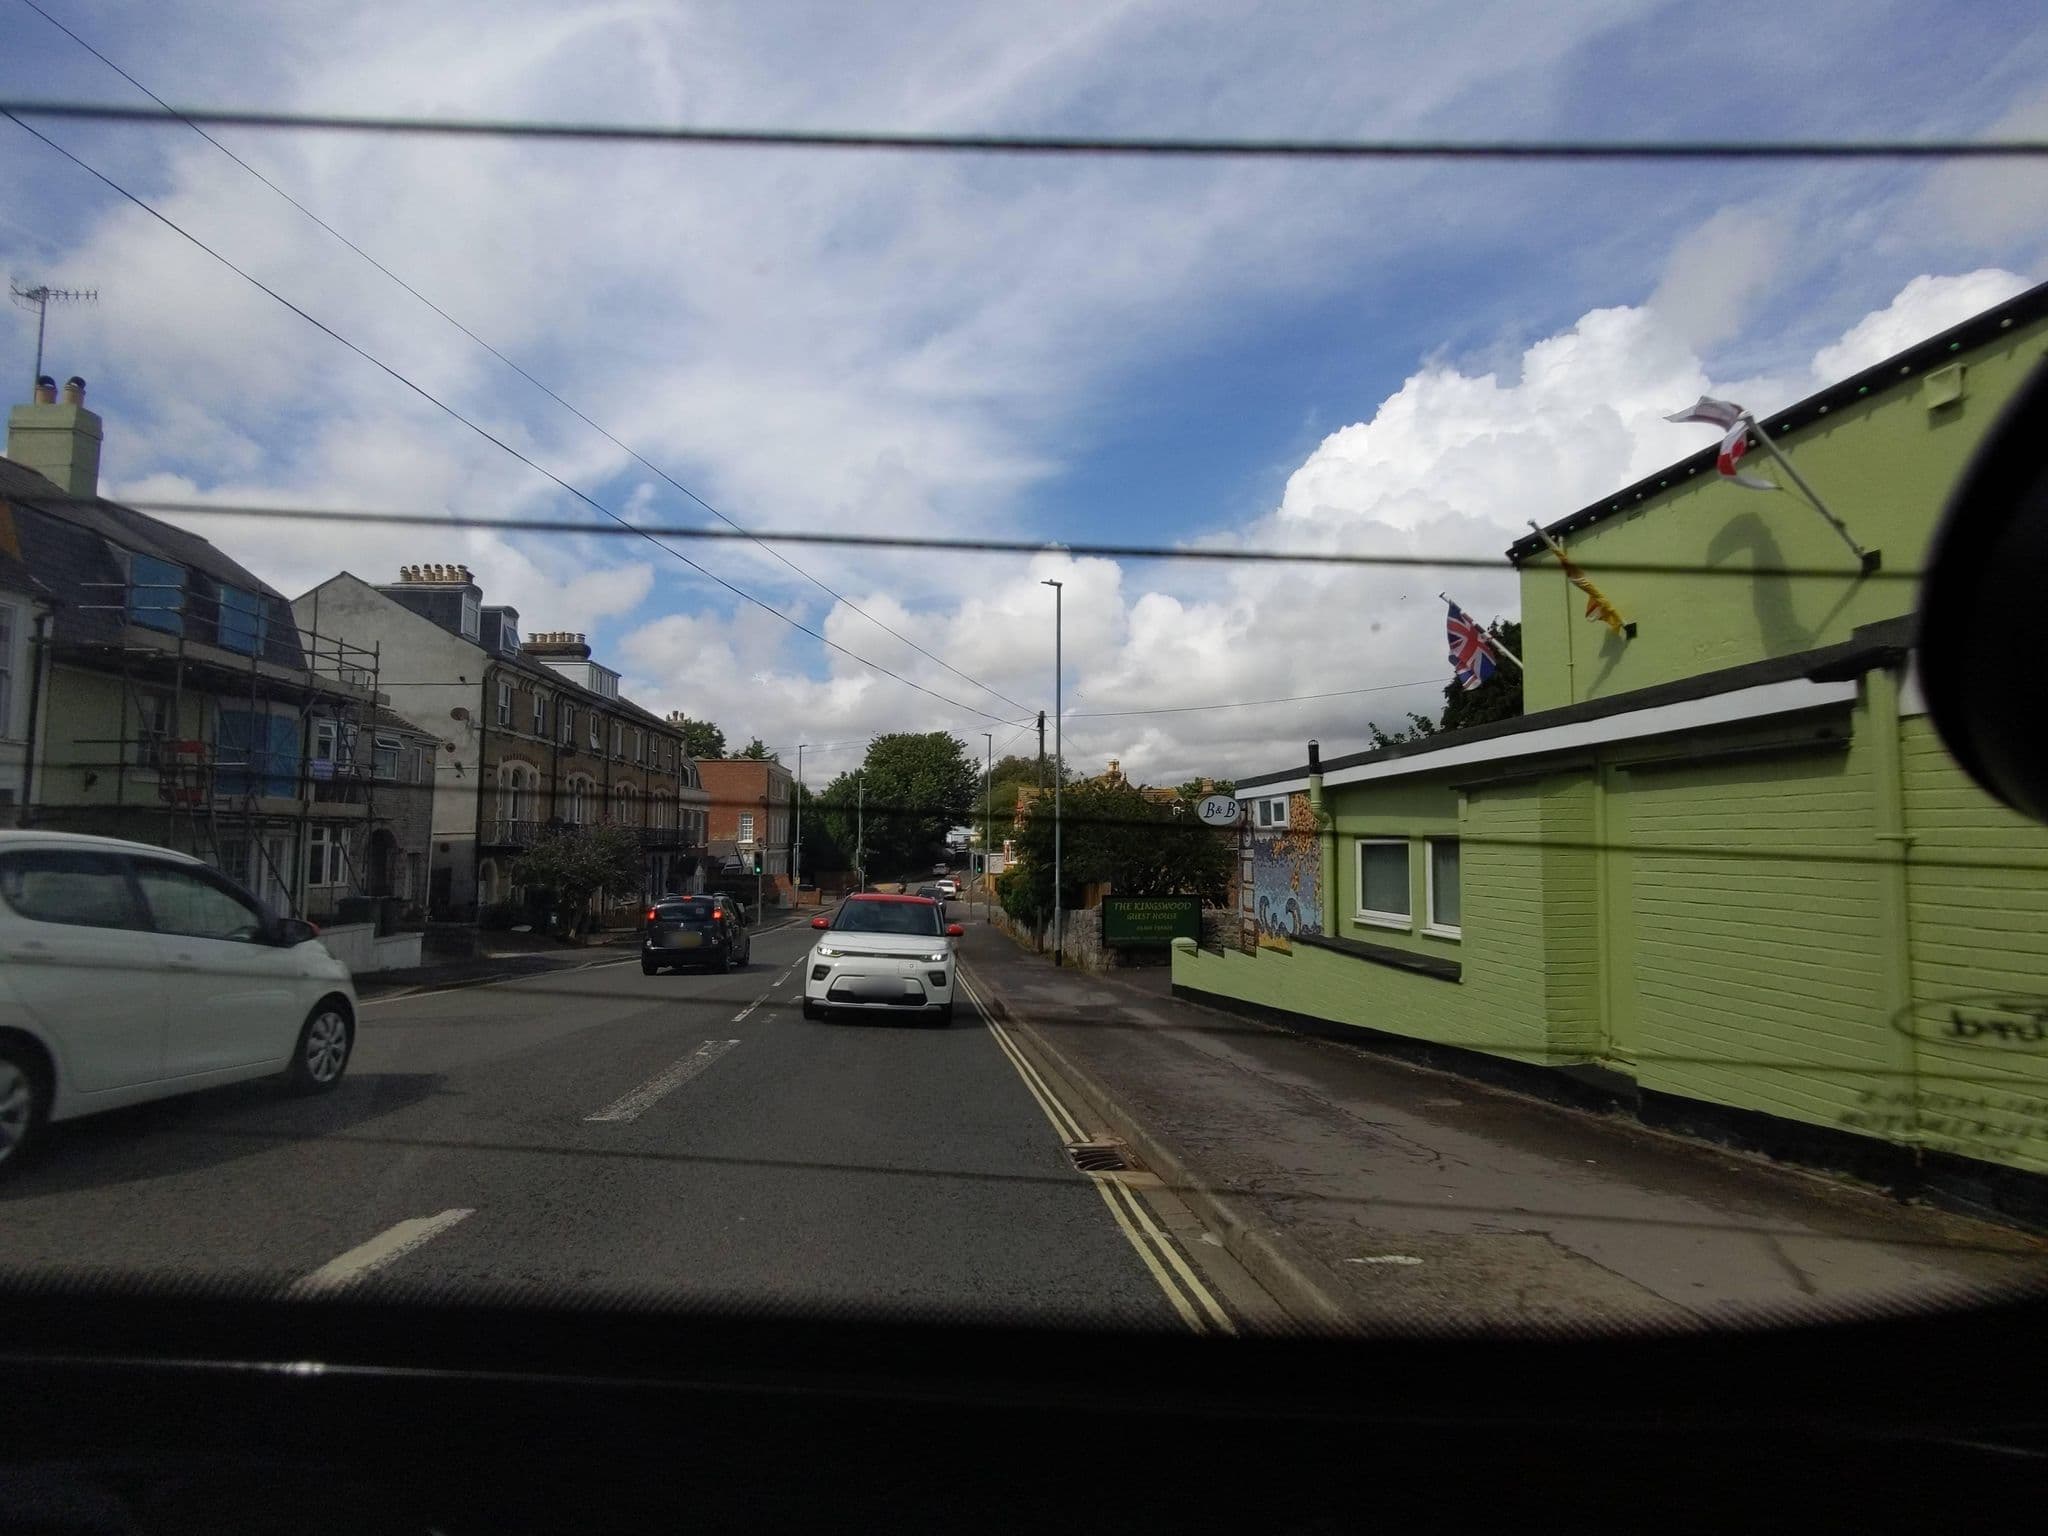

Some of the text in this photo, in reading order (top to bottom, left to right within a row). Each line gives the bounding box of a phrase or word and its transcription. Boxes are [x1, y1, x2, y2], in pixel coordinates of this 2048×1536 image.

[1113, 902, 1191, 911] THE KINGSWOOD
[1127, 912, 1177, 921] GUEST HOUSE
